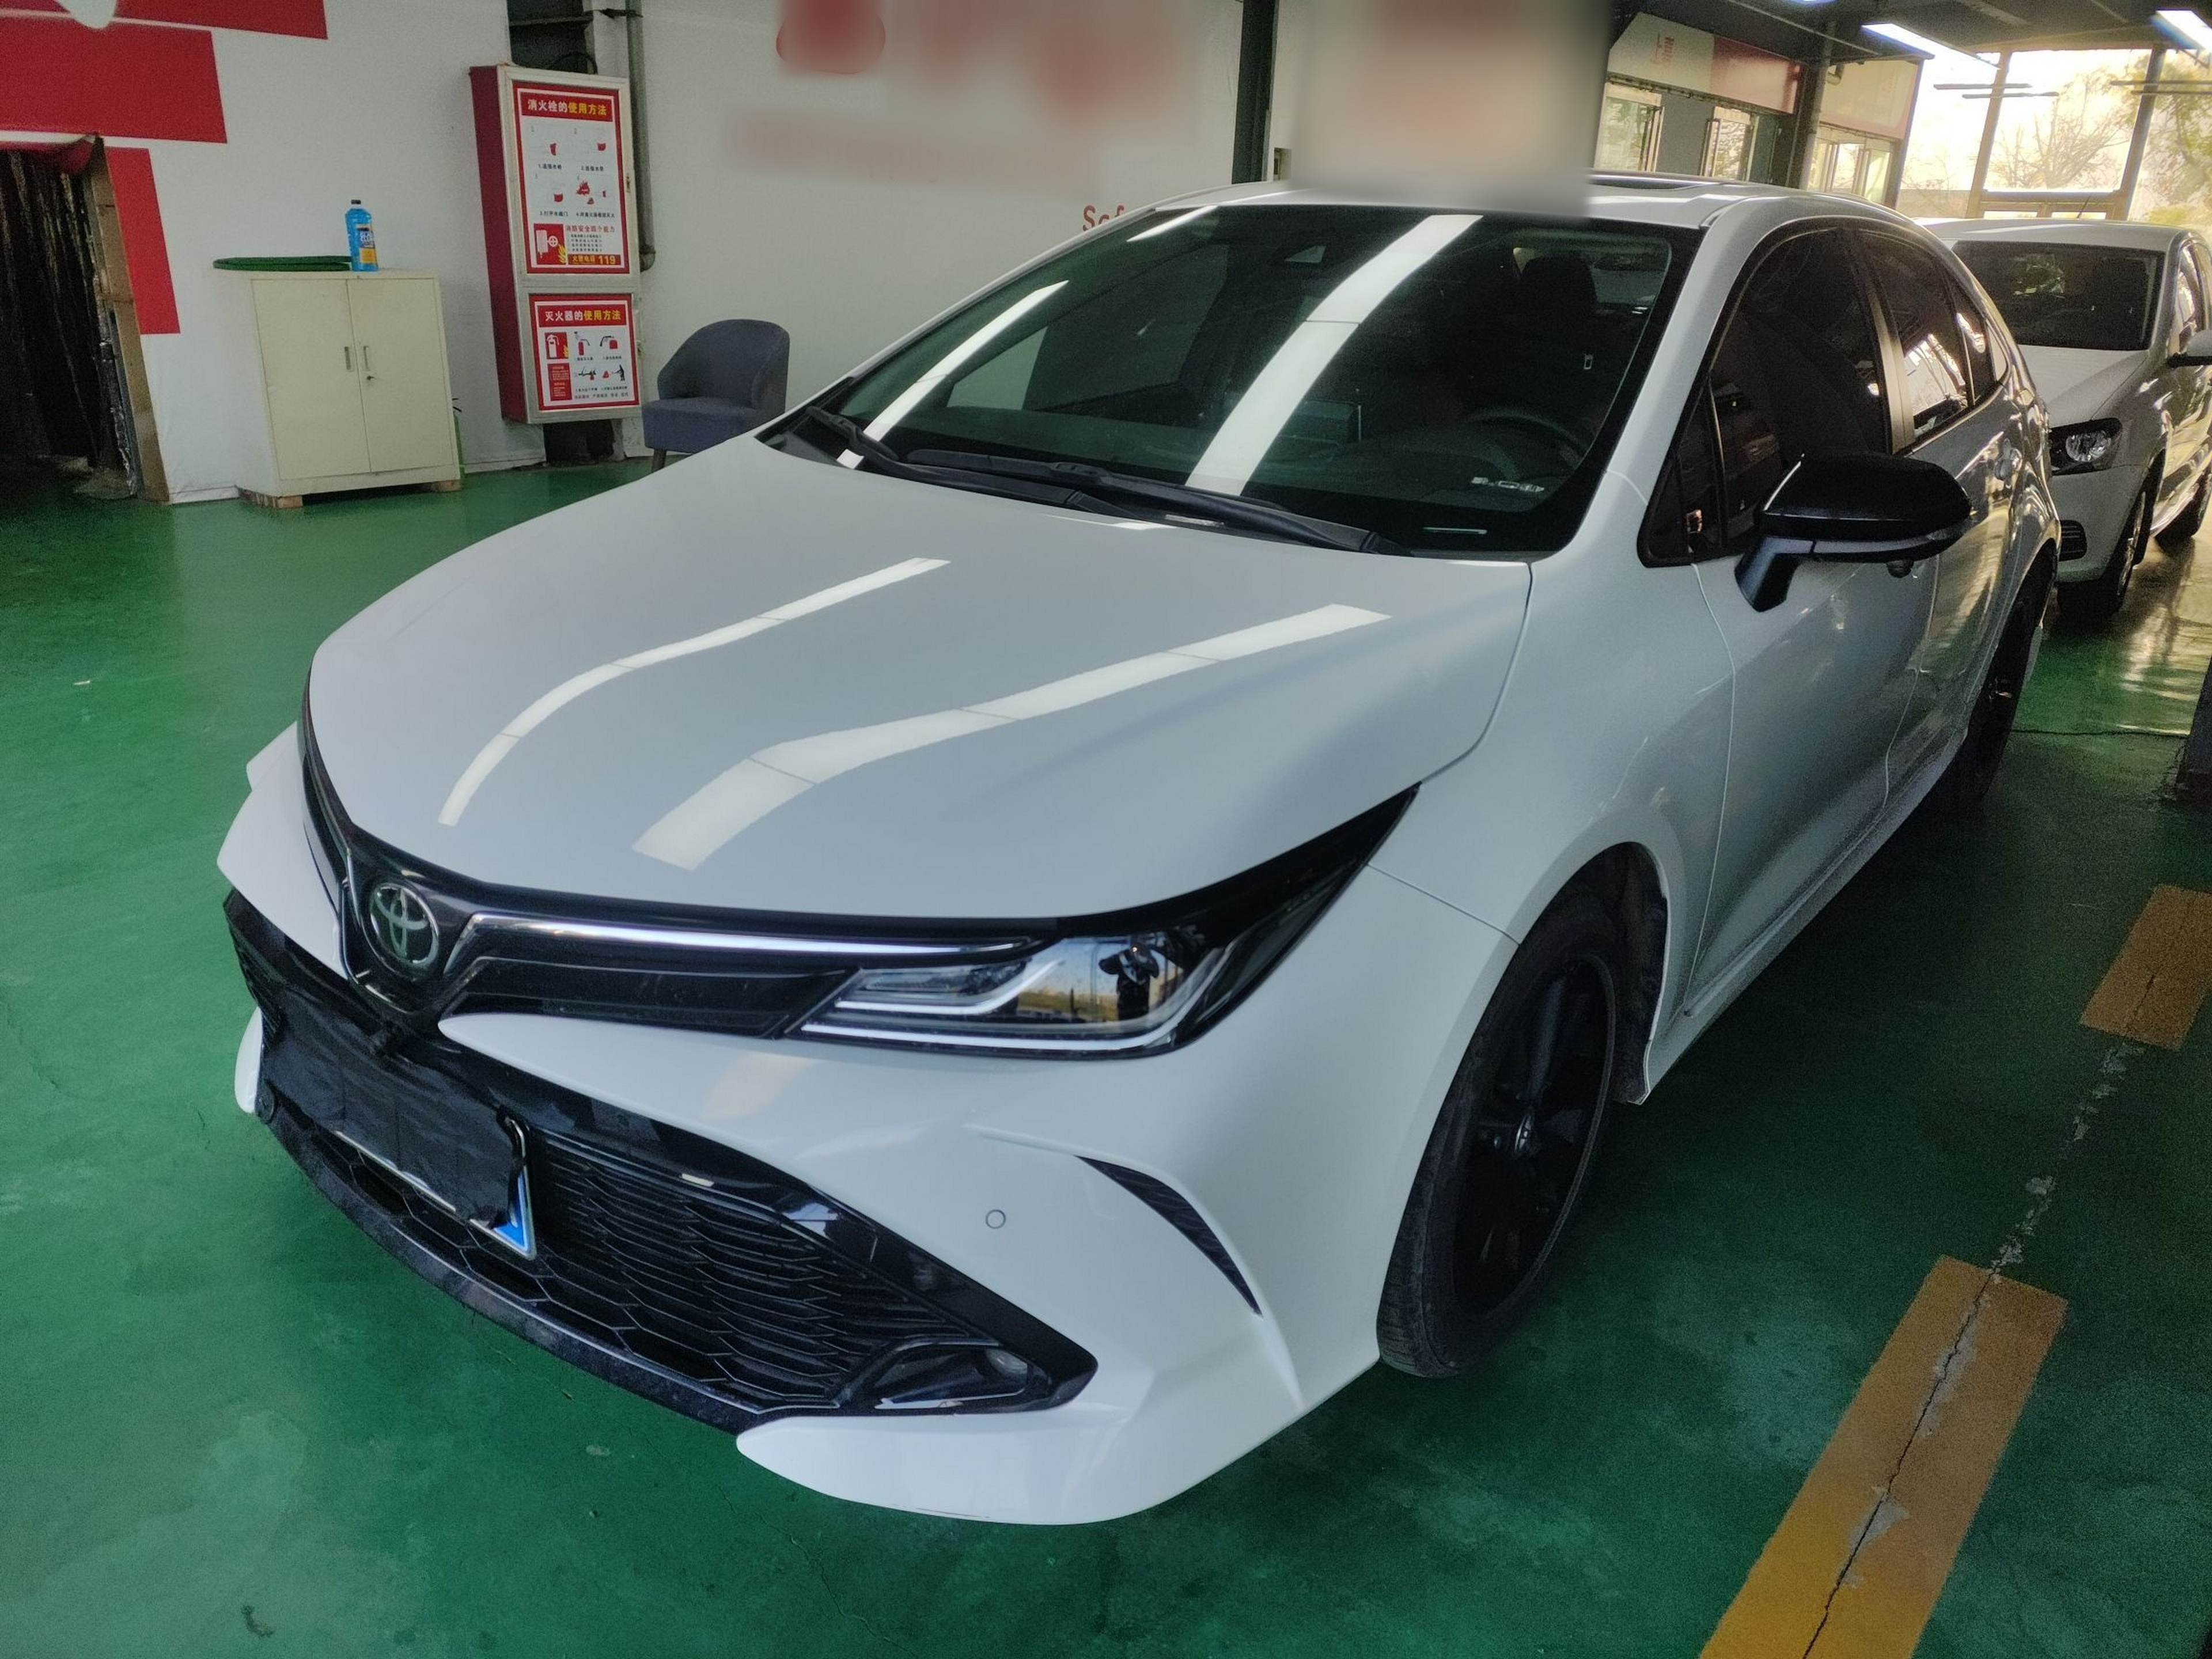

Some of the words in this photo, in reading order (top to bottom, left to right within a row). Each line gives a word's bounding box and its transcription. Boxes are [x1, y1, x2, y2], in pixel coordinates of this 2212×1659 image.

[528, 99, 607, 115] 消火栓的使用方法
[598, 255, 616, 264] 119
[545, 310, 622, 321] 灭火器的使用方法
